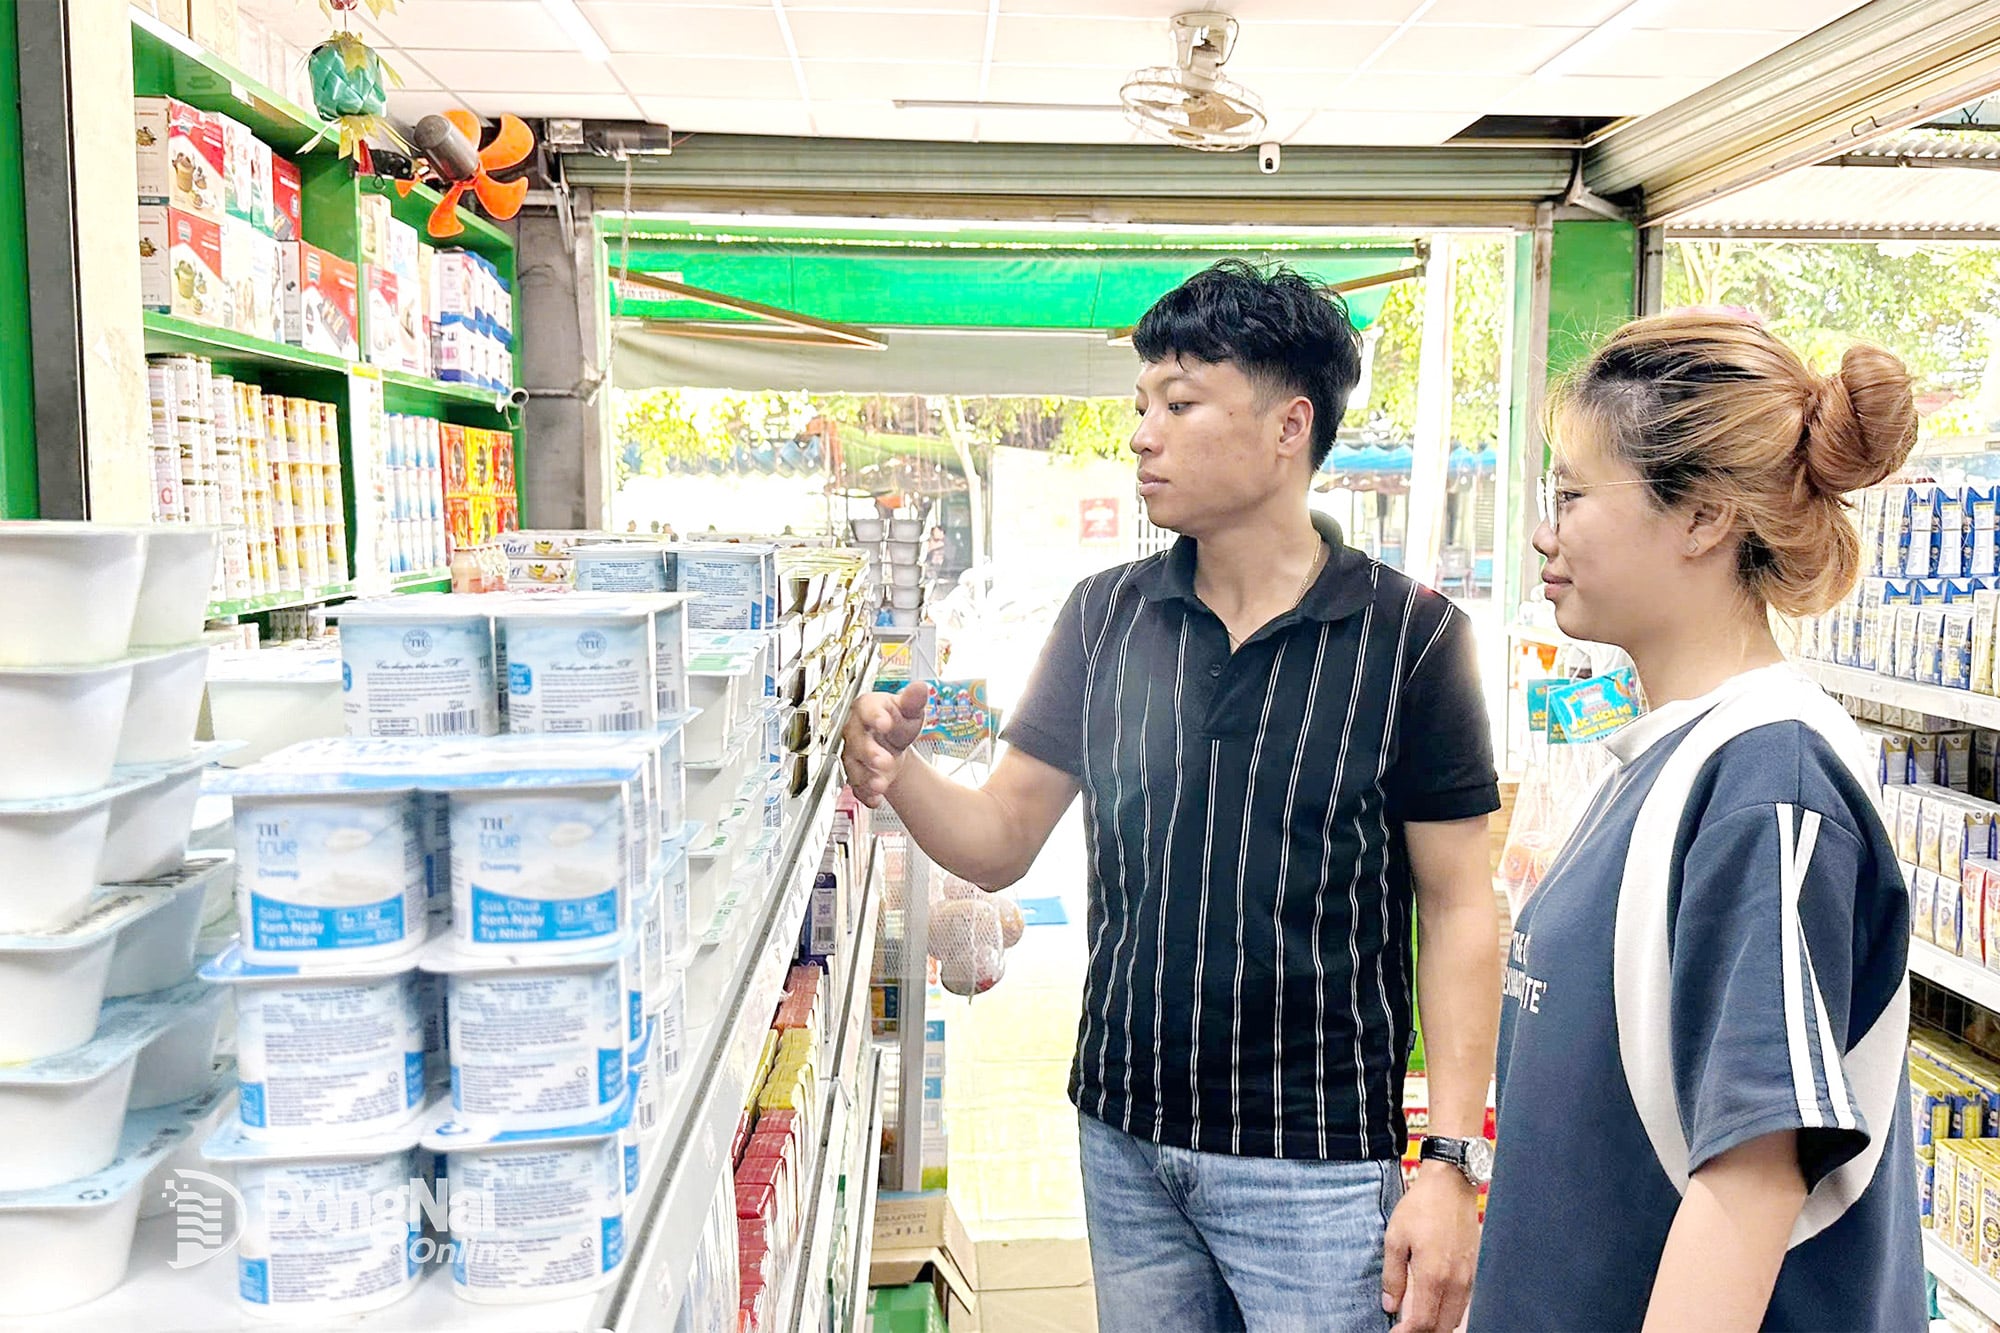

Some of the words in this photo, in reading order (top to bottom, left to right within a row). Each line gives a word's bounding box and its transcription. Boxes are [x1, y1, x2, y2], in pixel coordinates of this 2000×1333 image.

[480, 816, 503, 831] TH
[257, 837, 298, 855] true
[479, 832, 521, 849] true
